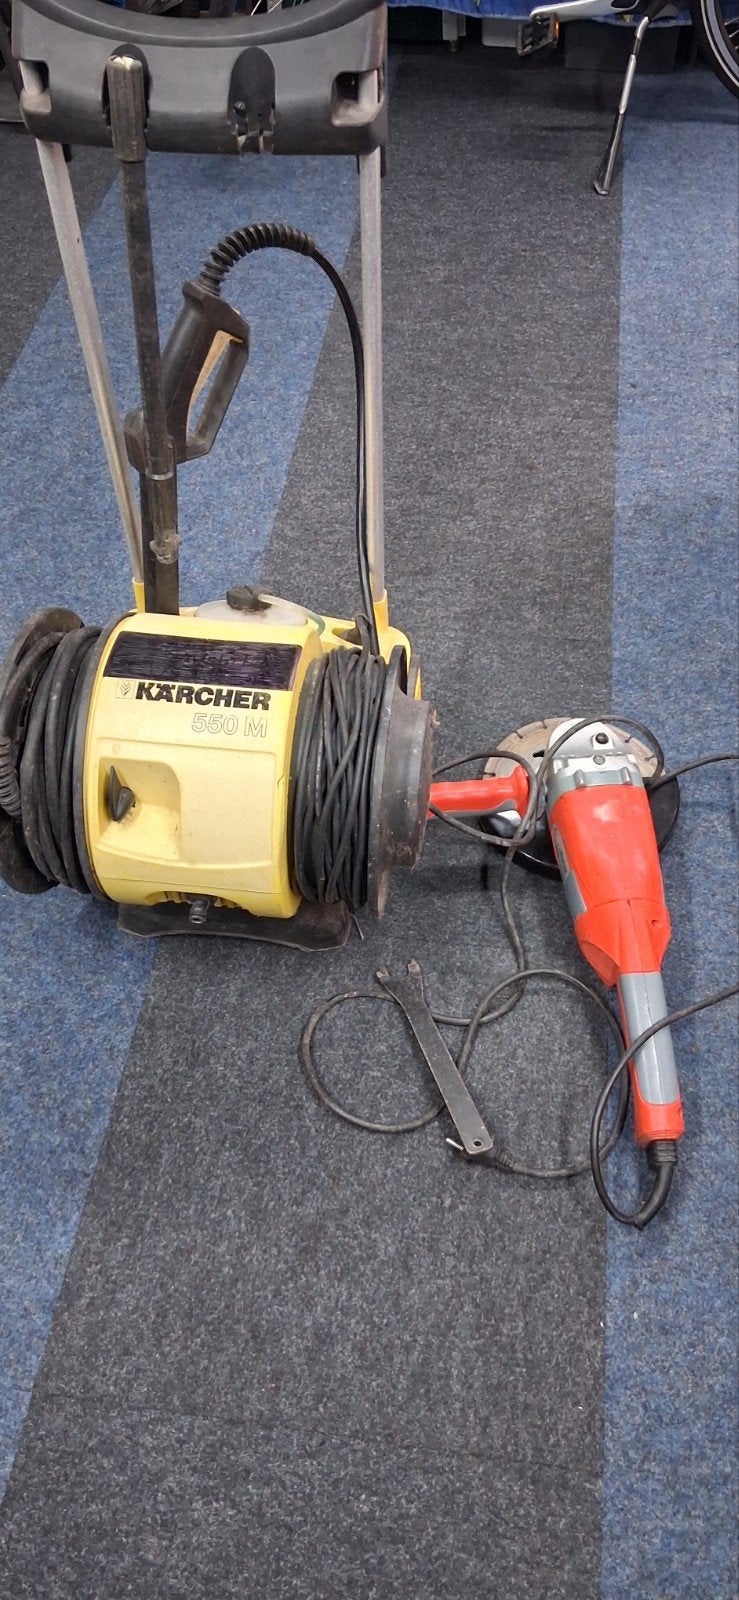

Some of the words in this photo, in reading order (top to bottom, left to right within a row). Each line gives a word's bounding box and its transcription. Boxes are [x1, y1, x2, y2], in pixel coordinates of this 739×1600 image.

[135, 681, 272, 710] KÄRCHER
[191, 712, 239, 735] 550
[244, 716, 268, 737] M
